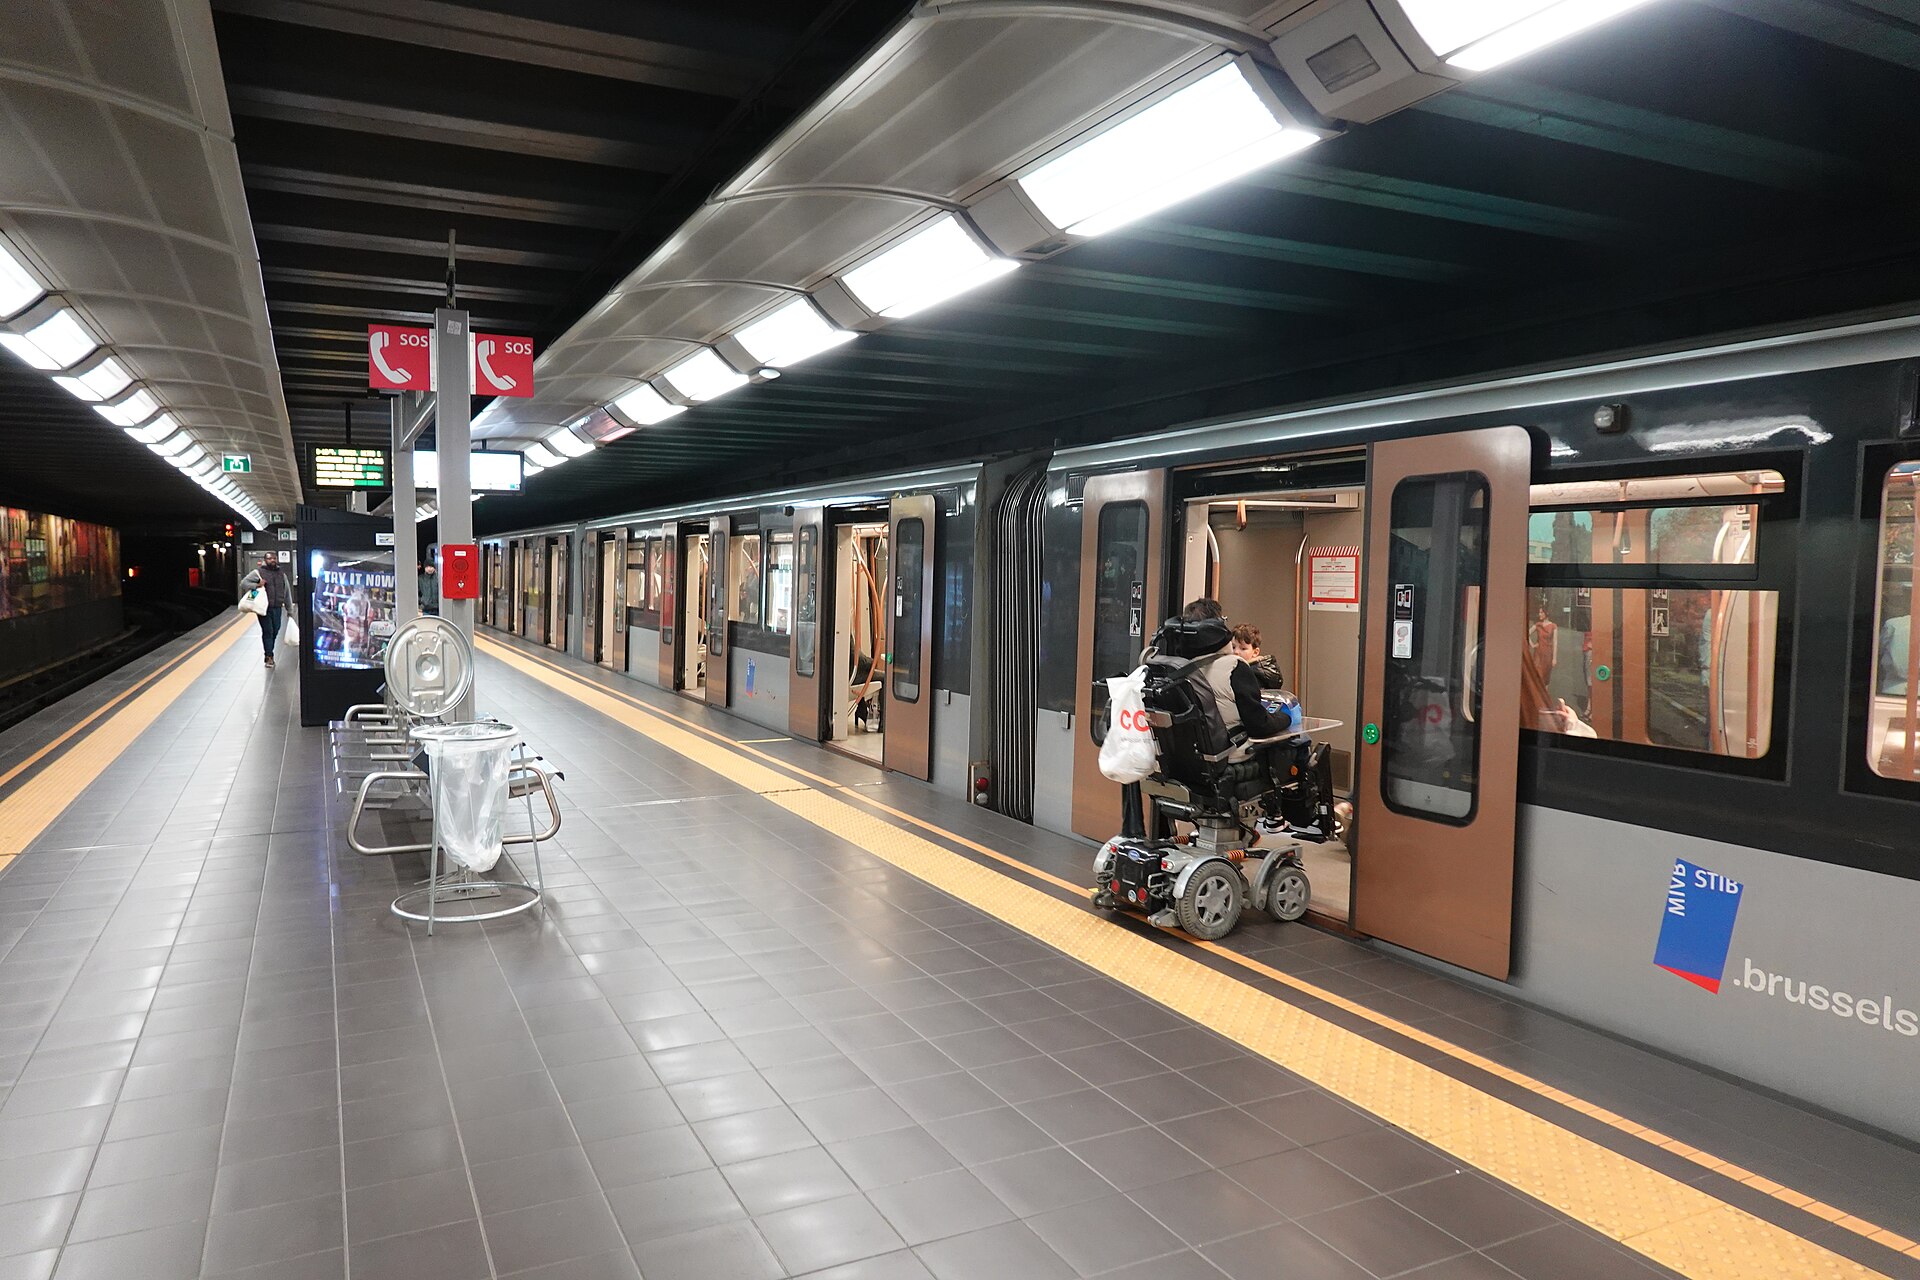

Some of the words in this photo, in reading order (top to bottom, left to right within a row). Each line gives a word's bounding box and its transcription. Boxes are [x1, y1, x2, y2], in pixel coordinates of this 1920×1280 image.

[400, 333, 429, 347] SOS
[505, 342, 532, 355] SOS
[323, 570, 347, 585] TRY
[349, 573, 362, 586] IT
[365, 574, 395, 588] NOW
[1668, 863, 1686, 917] MIVB
[1694, 869, 1739, 894] STIB
[1733, 958, 1919, 1036] .brussels
